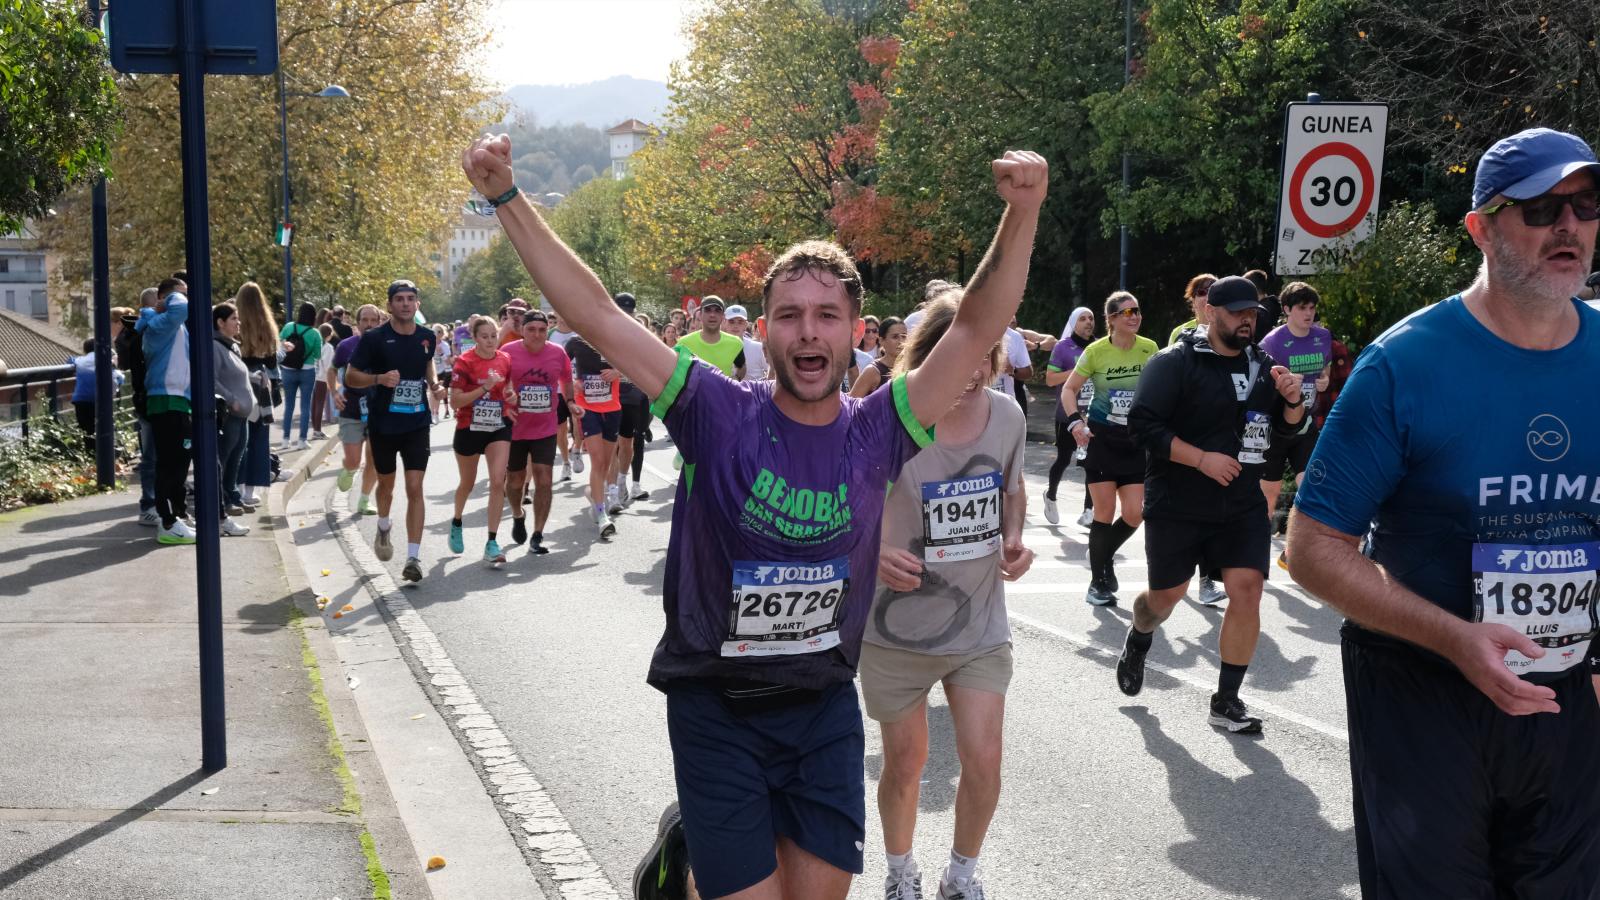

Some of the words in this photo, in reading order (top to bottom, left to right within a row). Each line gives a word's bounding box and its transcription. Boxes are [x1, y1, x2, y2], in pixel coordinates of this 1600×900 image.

[1302, 116, 1373, 133] GUNEA
[1310, 176, 1356, 207] 30
[521, 393, 549, 401] 20315
[951, 476, 994, 495] Joma
[932, 494, 997, 524] 19471
[1479, 515, 1508, 526] THE
[948, 527, 969, 536] JUAN
[1520, 548, 1588, 571] Joma
[773, 564, 835, 585] Joma
[740, 588, 840, 618] 26726
[1487, 579, 1593, 616] 18304
[1525, 623, 1560, 635] LLUIS
